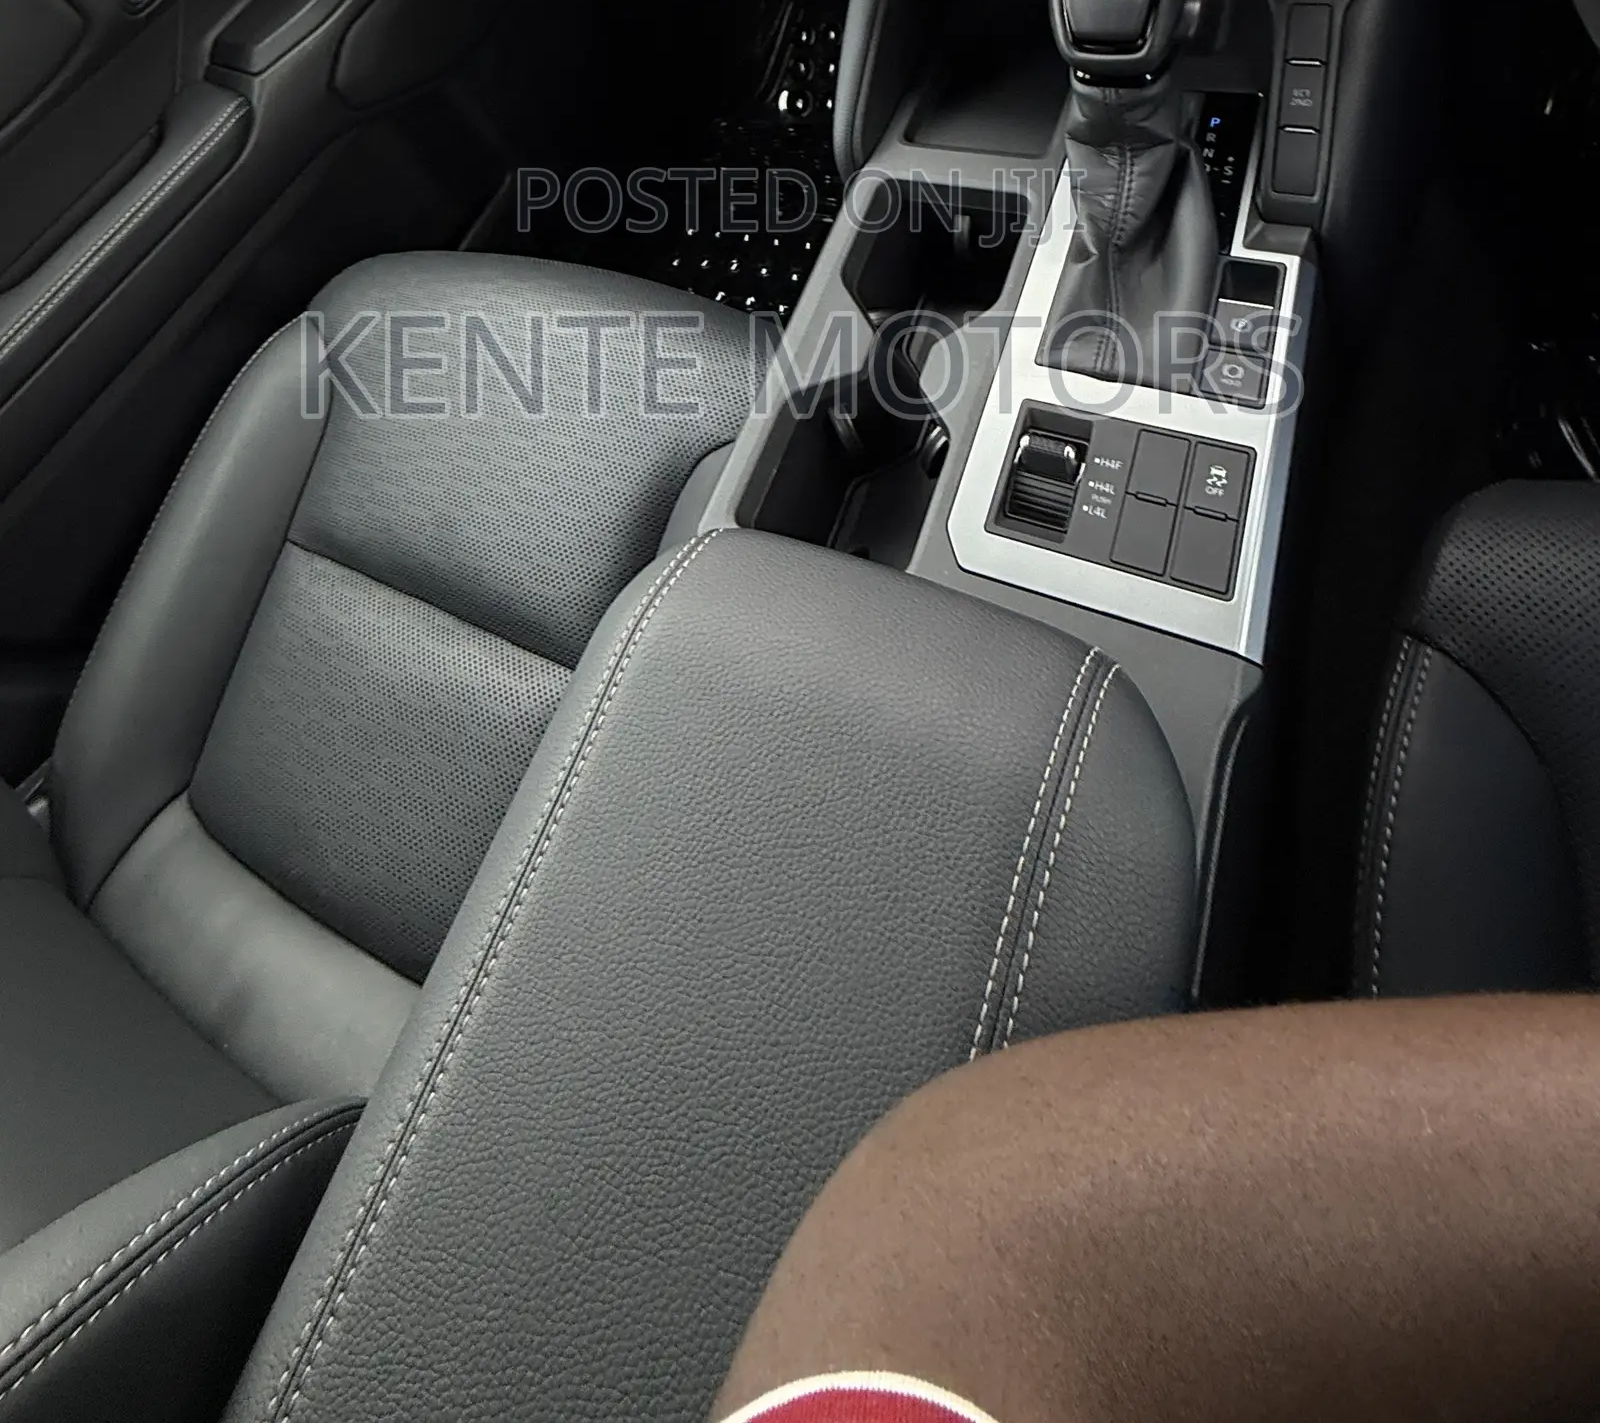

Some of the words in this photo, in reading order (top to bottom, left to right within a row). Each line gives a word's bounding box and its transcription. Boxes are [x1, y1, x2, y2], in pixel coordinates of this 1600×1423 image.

[1209, 116, 1221, 128] P
[1206, 132, 1217, 143] R
[1202, 146, 1216, 158] N
[1223, 165, 1235, 177] S
[1094, 479, 1116, 496] H4L
[1205, 485, 1225, 498] OFF
[1088, 504, 1108, 519] L4L
